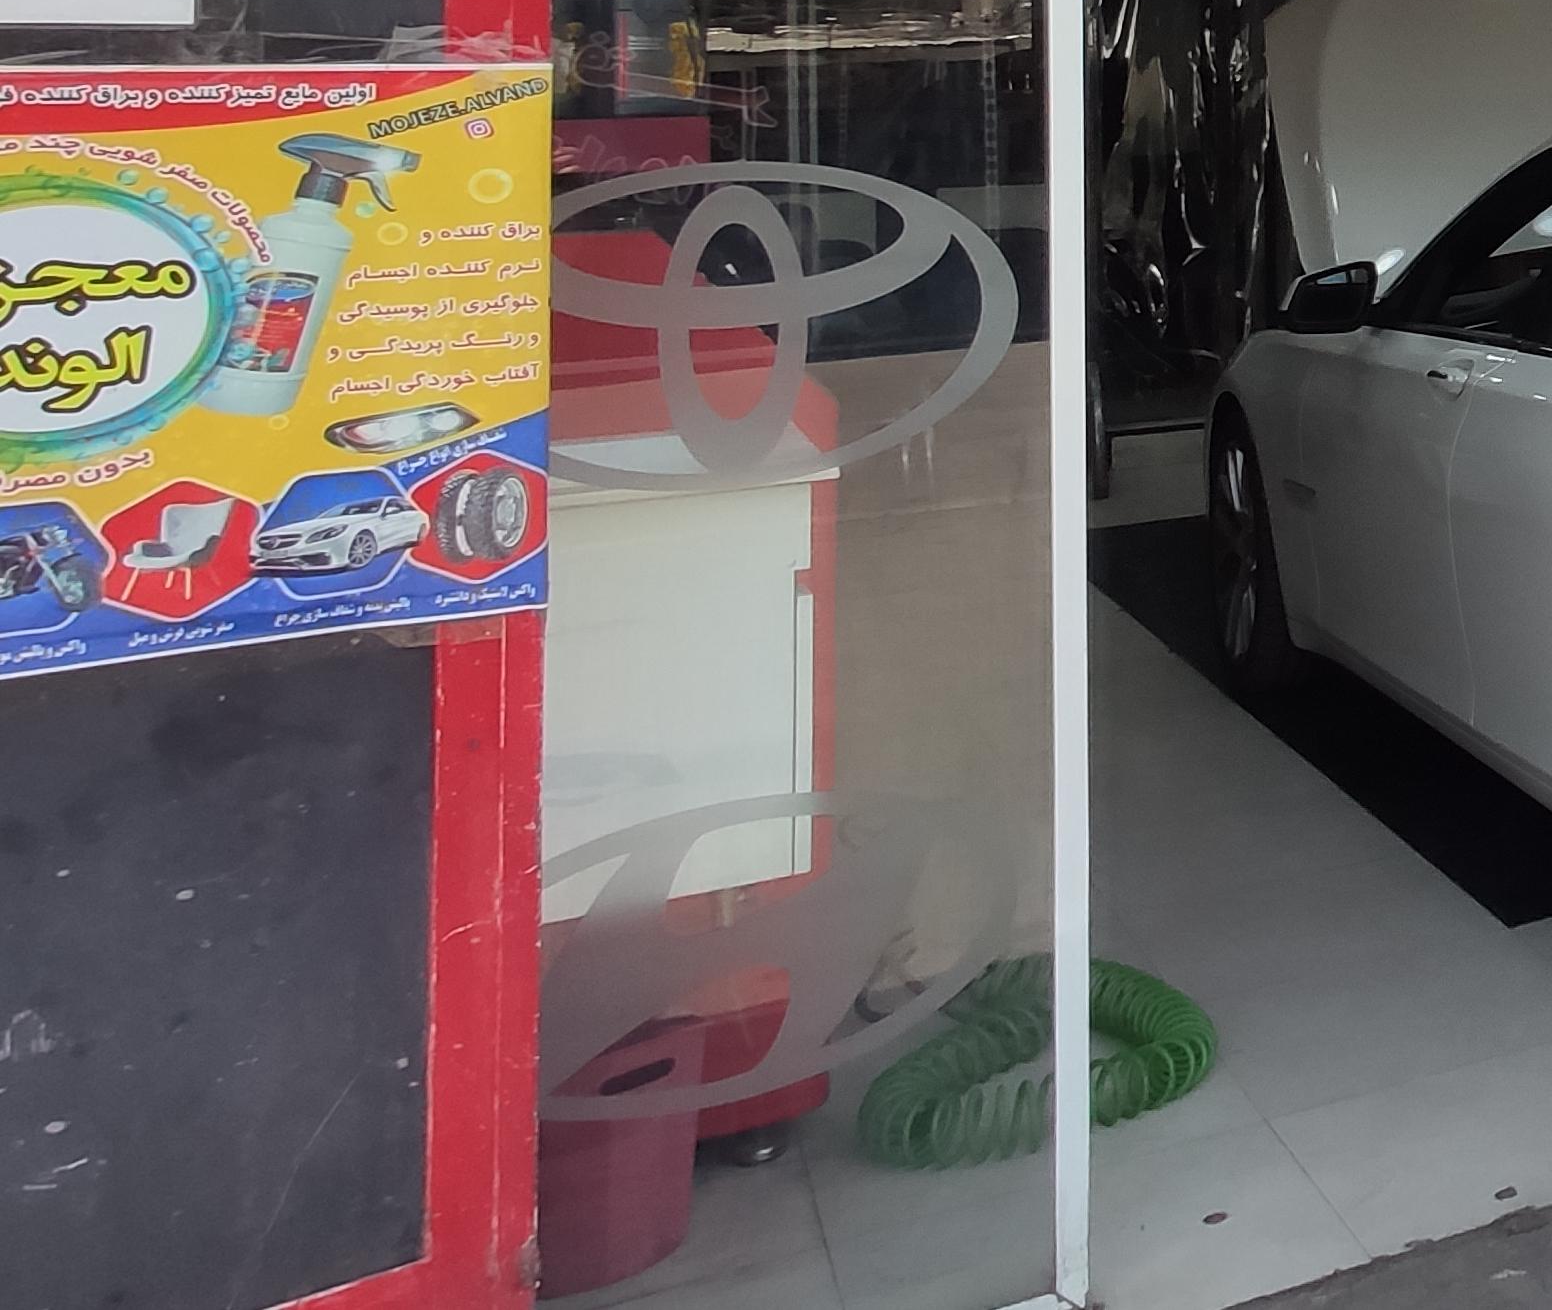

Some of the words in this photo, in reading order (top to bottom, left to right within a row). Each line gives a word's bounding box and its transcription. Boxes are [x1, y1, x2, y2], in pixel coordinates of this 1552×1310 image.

[24, 84, 89, 106] کننده
[93, 85, 142, 110] براق
[147, 89, 160, 110] و
[166, 83, 230, 106] کننده
[230, 83, 277, 110] تمیز
[279, 83, 321, 111] مایع
[325, 82, 376, 108] اولین
[368, 77, 548, 139] MOJEZE.ALVAND
[29, 136, 82, 157] چند
[88, 142, 160, 169] شویی
[158, 160, 210, 192] صفر
[210, 188, 274, 264] محصولات
[420, 229, 433, 246] و
[439, 223, 494, 240] کننده
[501, 222, 541, 240] براق
[347, 262, 417, 289] اجسام
[426, 259, 491, 277] کننده
[498, 258, 541, 281] نرم
[338, 301, 429, 324] پوسیدگی
[437, 298, 454, 316] از
[462, 293, 539, 315] جلوگیری
[348, 336, 443, 360] پریدگی
[450, 331, 523, 349] رنگ
[528, 331, 540, 347] و
[327, 345, 341, 361] و
[397, 371, 476, 394] خوردگی
[484, 362, 540, 384] آفتاب
[330, 377, 390, 403] اجسام
[77, 448, 153, 484] بدون
[0, 472, 66, 495] مصر
